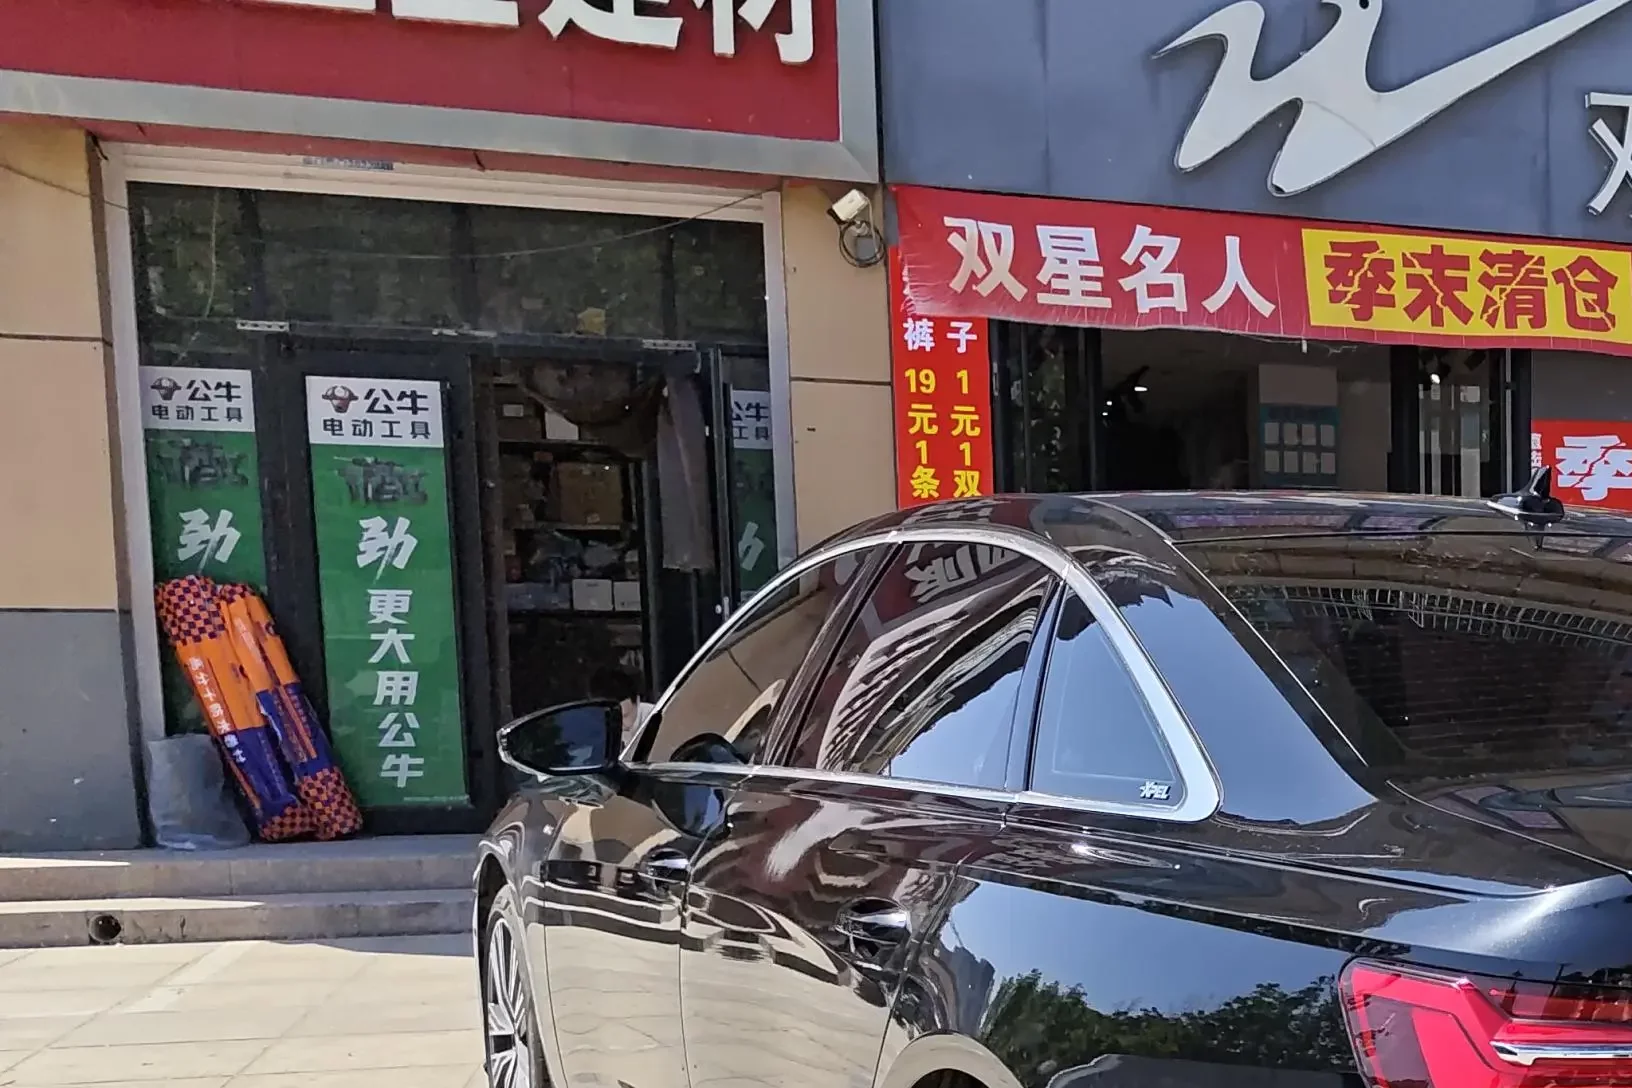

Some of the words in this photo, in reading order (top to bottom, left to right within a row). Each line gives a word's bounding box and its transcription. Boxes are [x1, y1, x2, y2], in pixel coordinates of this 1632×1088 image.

[943, 215, 1276, 319] 双星名人
[1323, 240, 1618, 332] 季末清仓
[186, 379, 242, 403] 公牛
[364, 388, 429, 415] 公牛
[151, 404, 244, 423] 电动工具
[323, 417, 431, 440] 电动工具
[178, 507, 242, 573] 劲
[356, 516, 418, 583] 劲
[367, 589, 424, 788] 更大用公牛
[1140, 781, 1170, 801] XPEL
